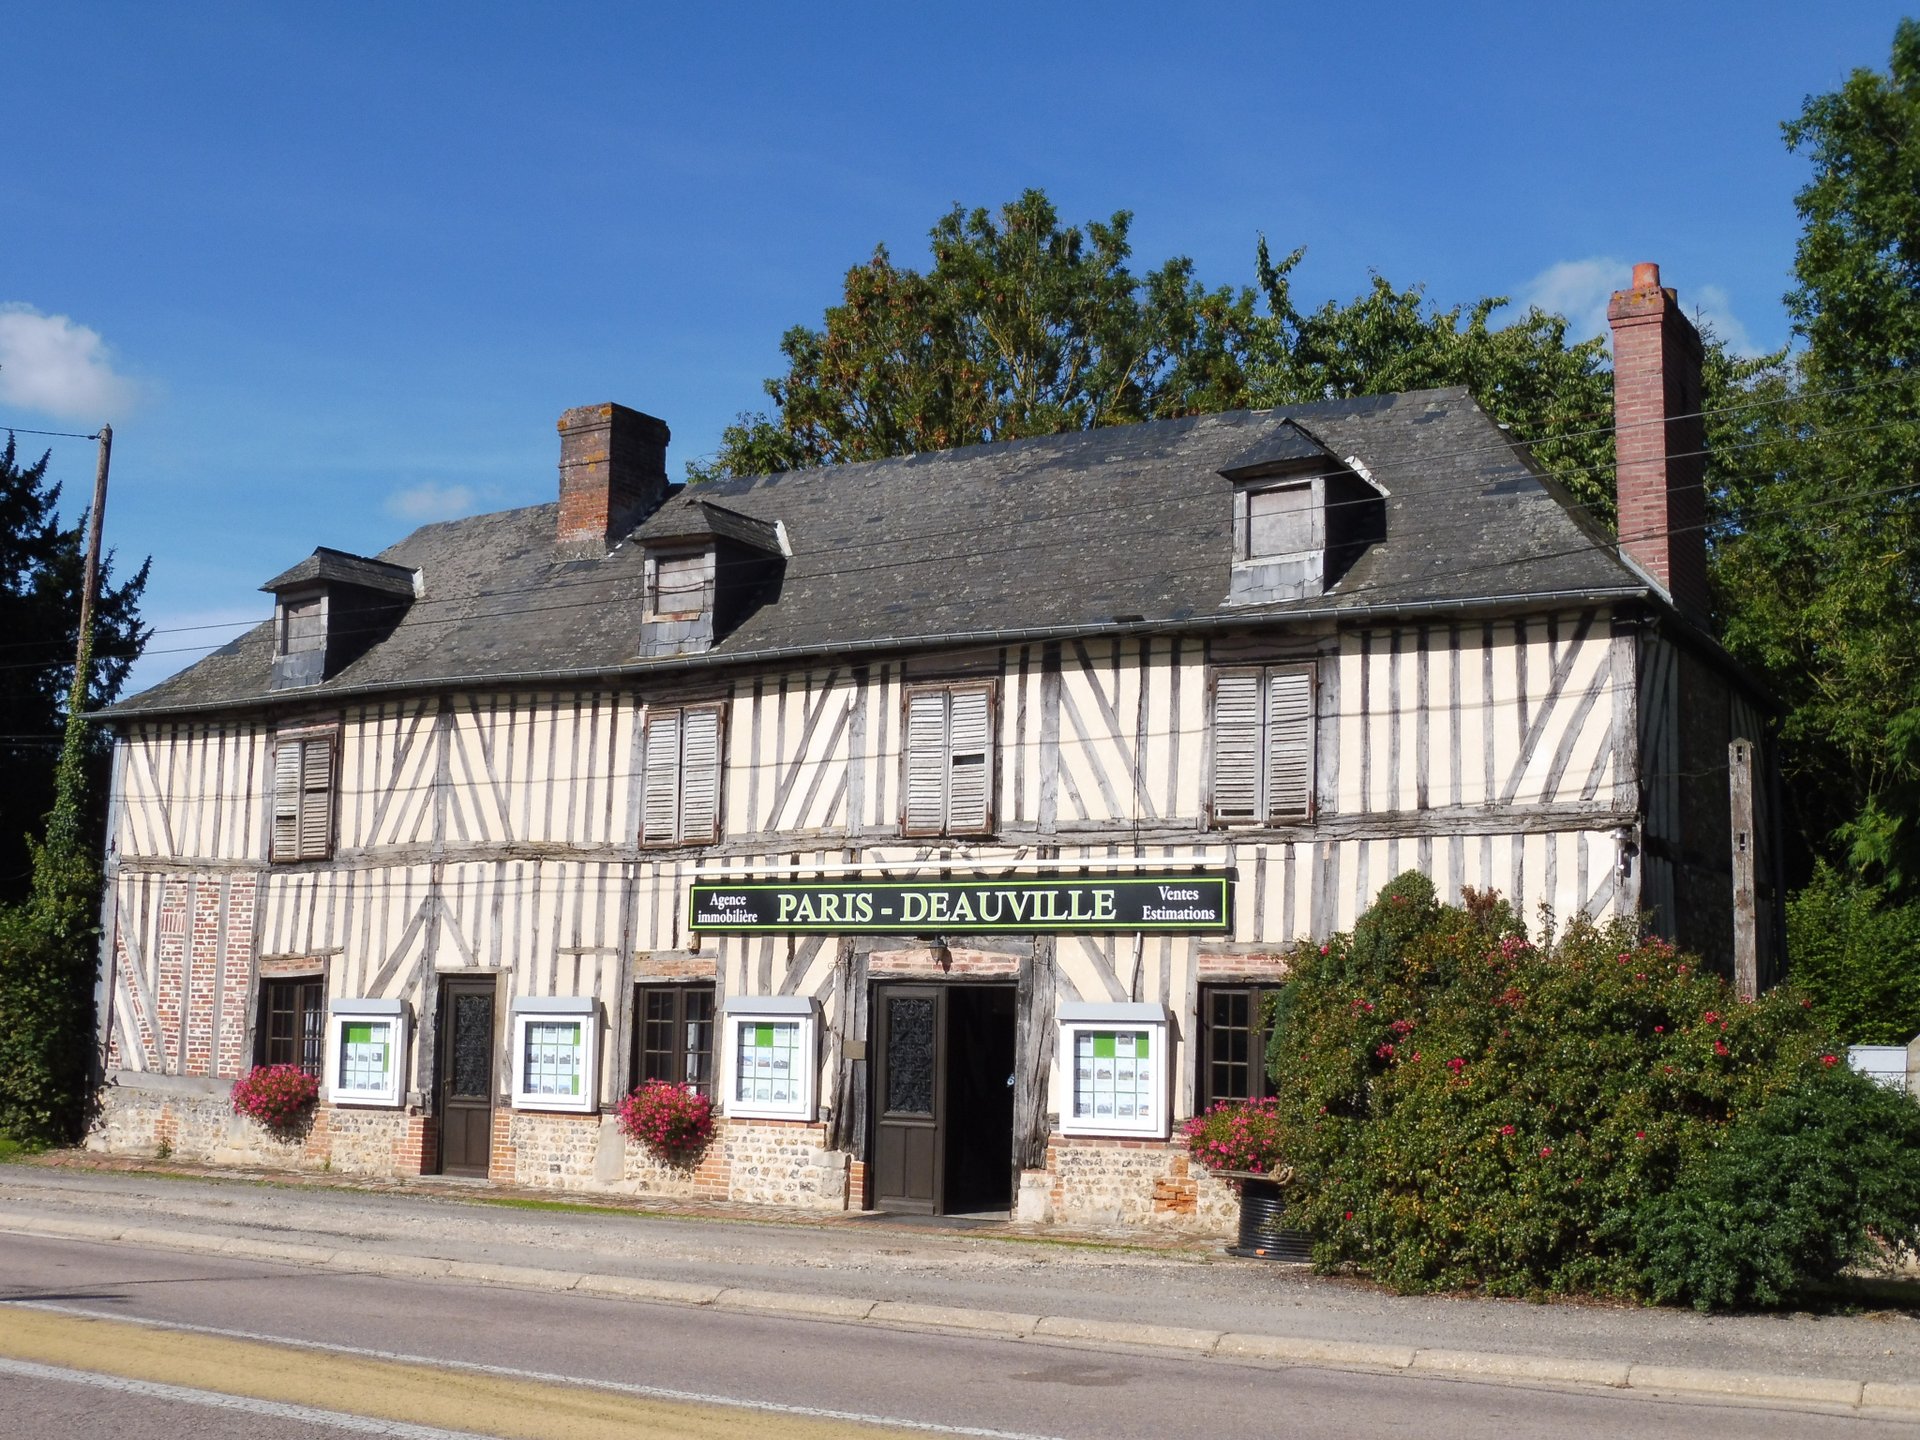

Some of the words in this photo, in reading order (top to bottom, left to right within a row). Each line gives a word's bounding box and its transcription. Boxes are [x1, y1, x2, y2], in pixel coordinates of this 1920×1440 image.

[709, 892, 747, 909] Agence
[1157, 885, 1200, 901] Ventes
[776, 892, 874, 923] PARIS
[880, 907, 893, 915] -
[899, 889, 1117, 923] DEAUVILLE
[1141, 905, 1216, 921] Estimations
[697, 908, 758, 924] immobilière
